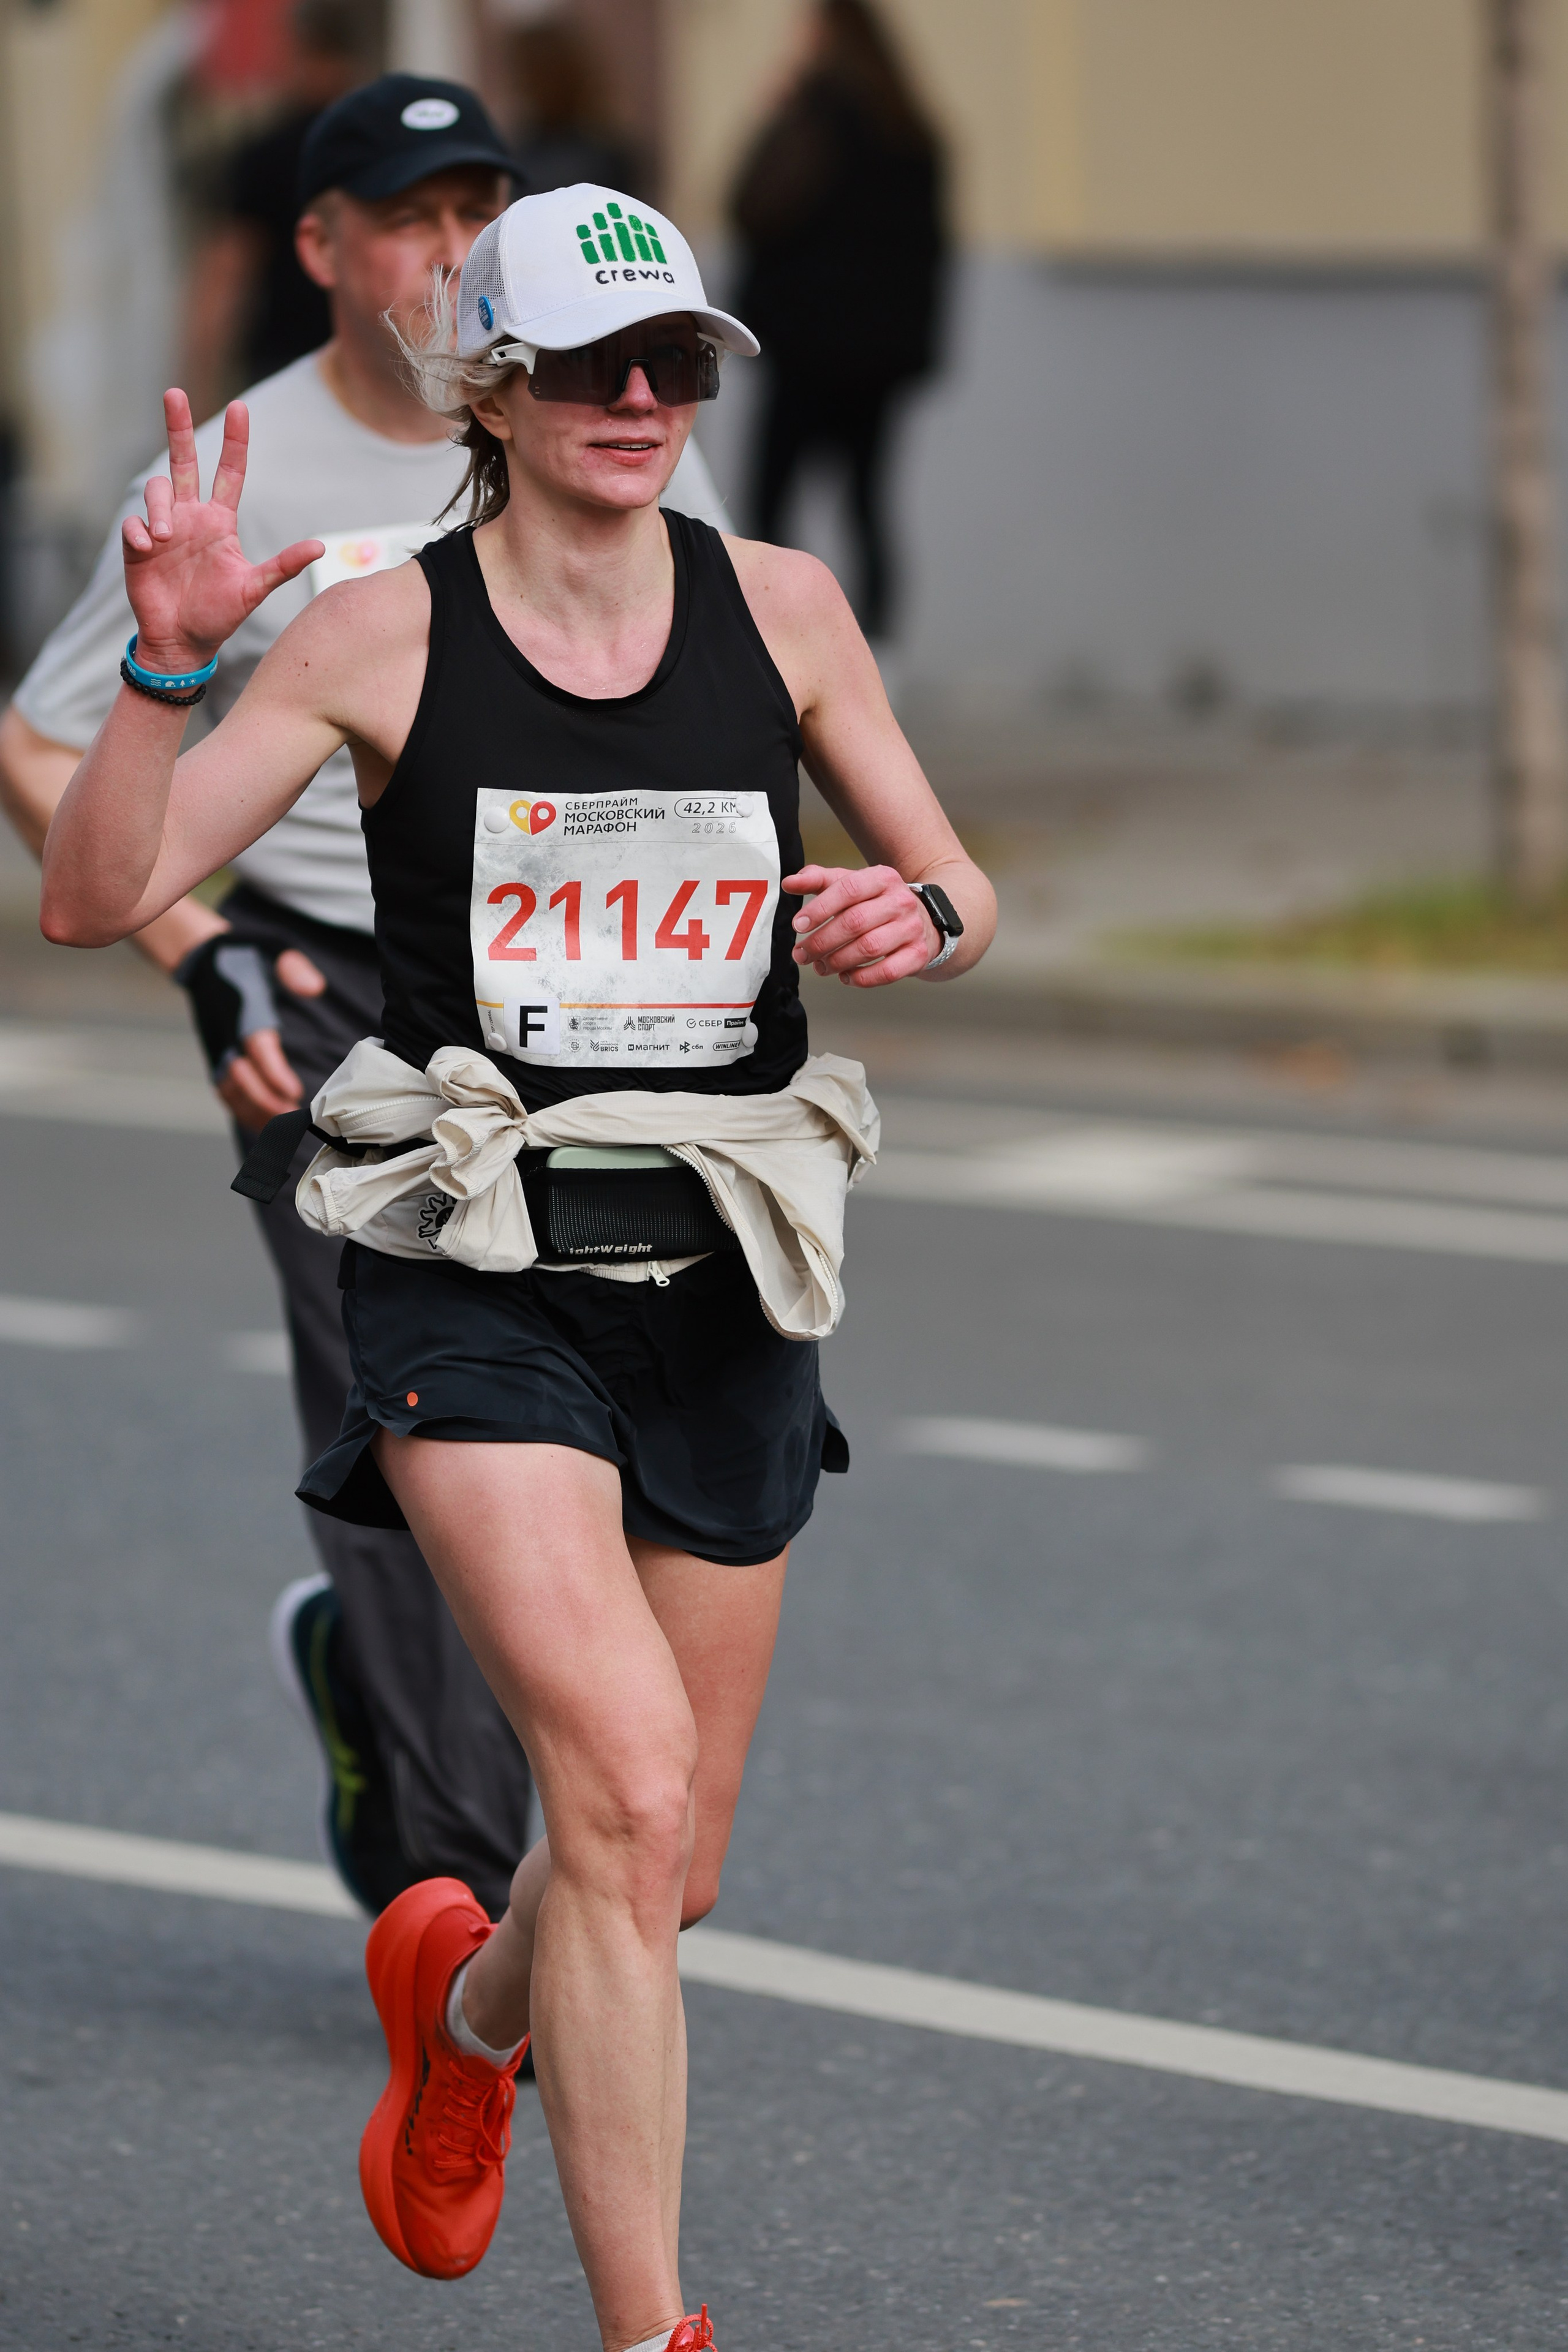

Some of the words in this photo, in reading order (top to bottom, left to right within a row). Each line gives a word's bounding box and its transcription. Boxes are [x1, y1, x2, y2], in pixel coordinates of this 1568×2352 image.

[595, 269, 675, 284] crewa
[565, 797, 638, 810] СБЕРПРАЙМ
[683, 802, 715, 815] 42,2
[565, 807, 665, 823] МОСКОВСКИЙ
[564, 822, 637, 836] МАРАФОН
[692, 822, 736, 834] 2026
[486, 880, 769, 961] 21147
[638, 1014, 675, 1023] МОСКОВСКИЙ
[519, 1005, 548, 1048] F
[558, 1243, 653, 1254] ightWeight
